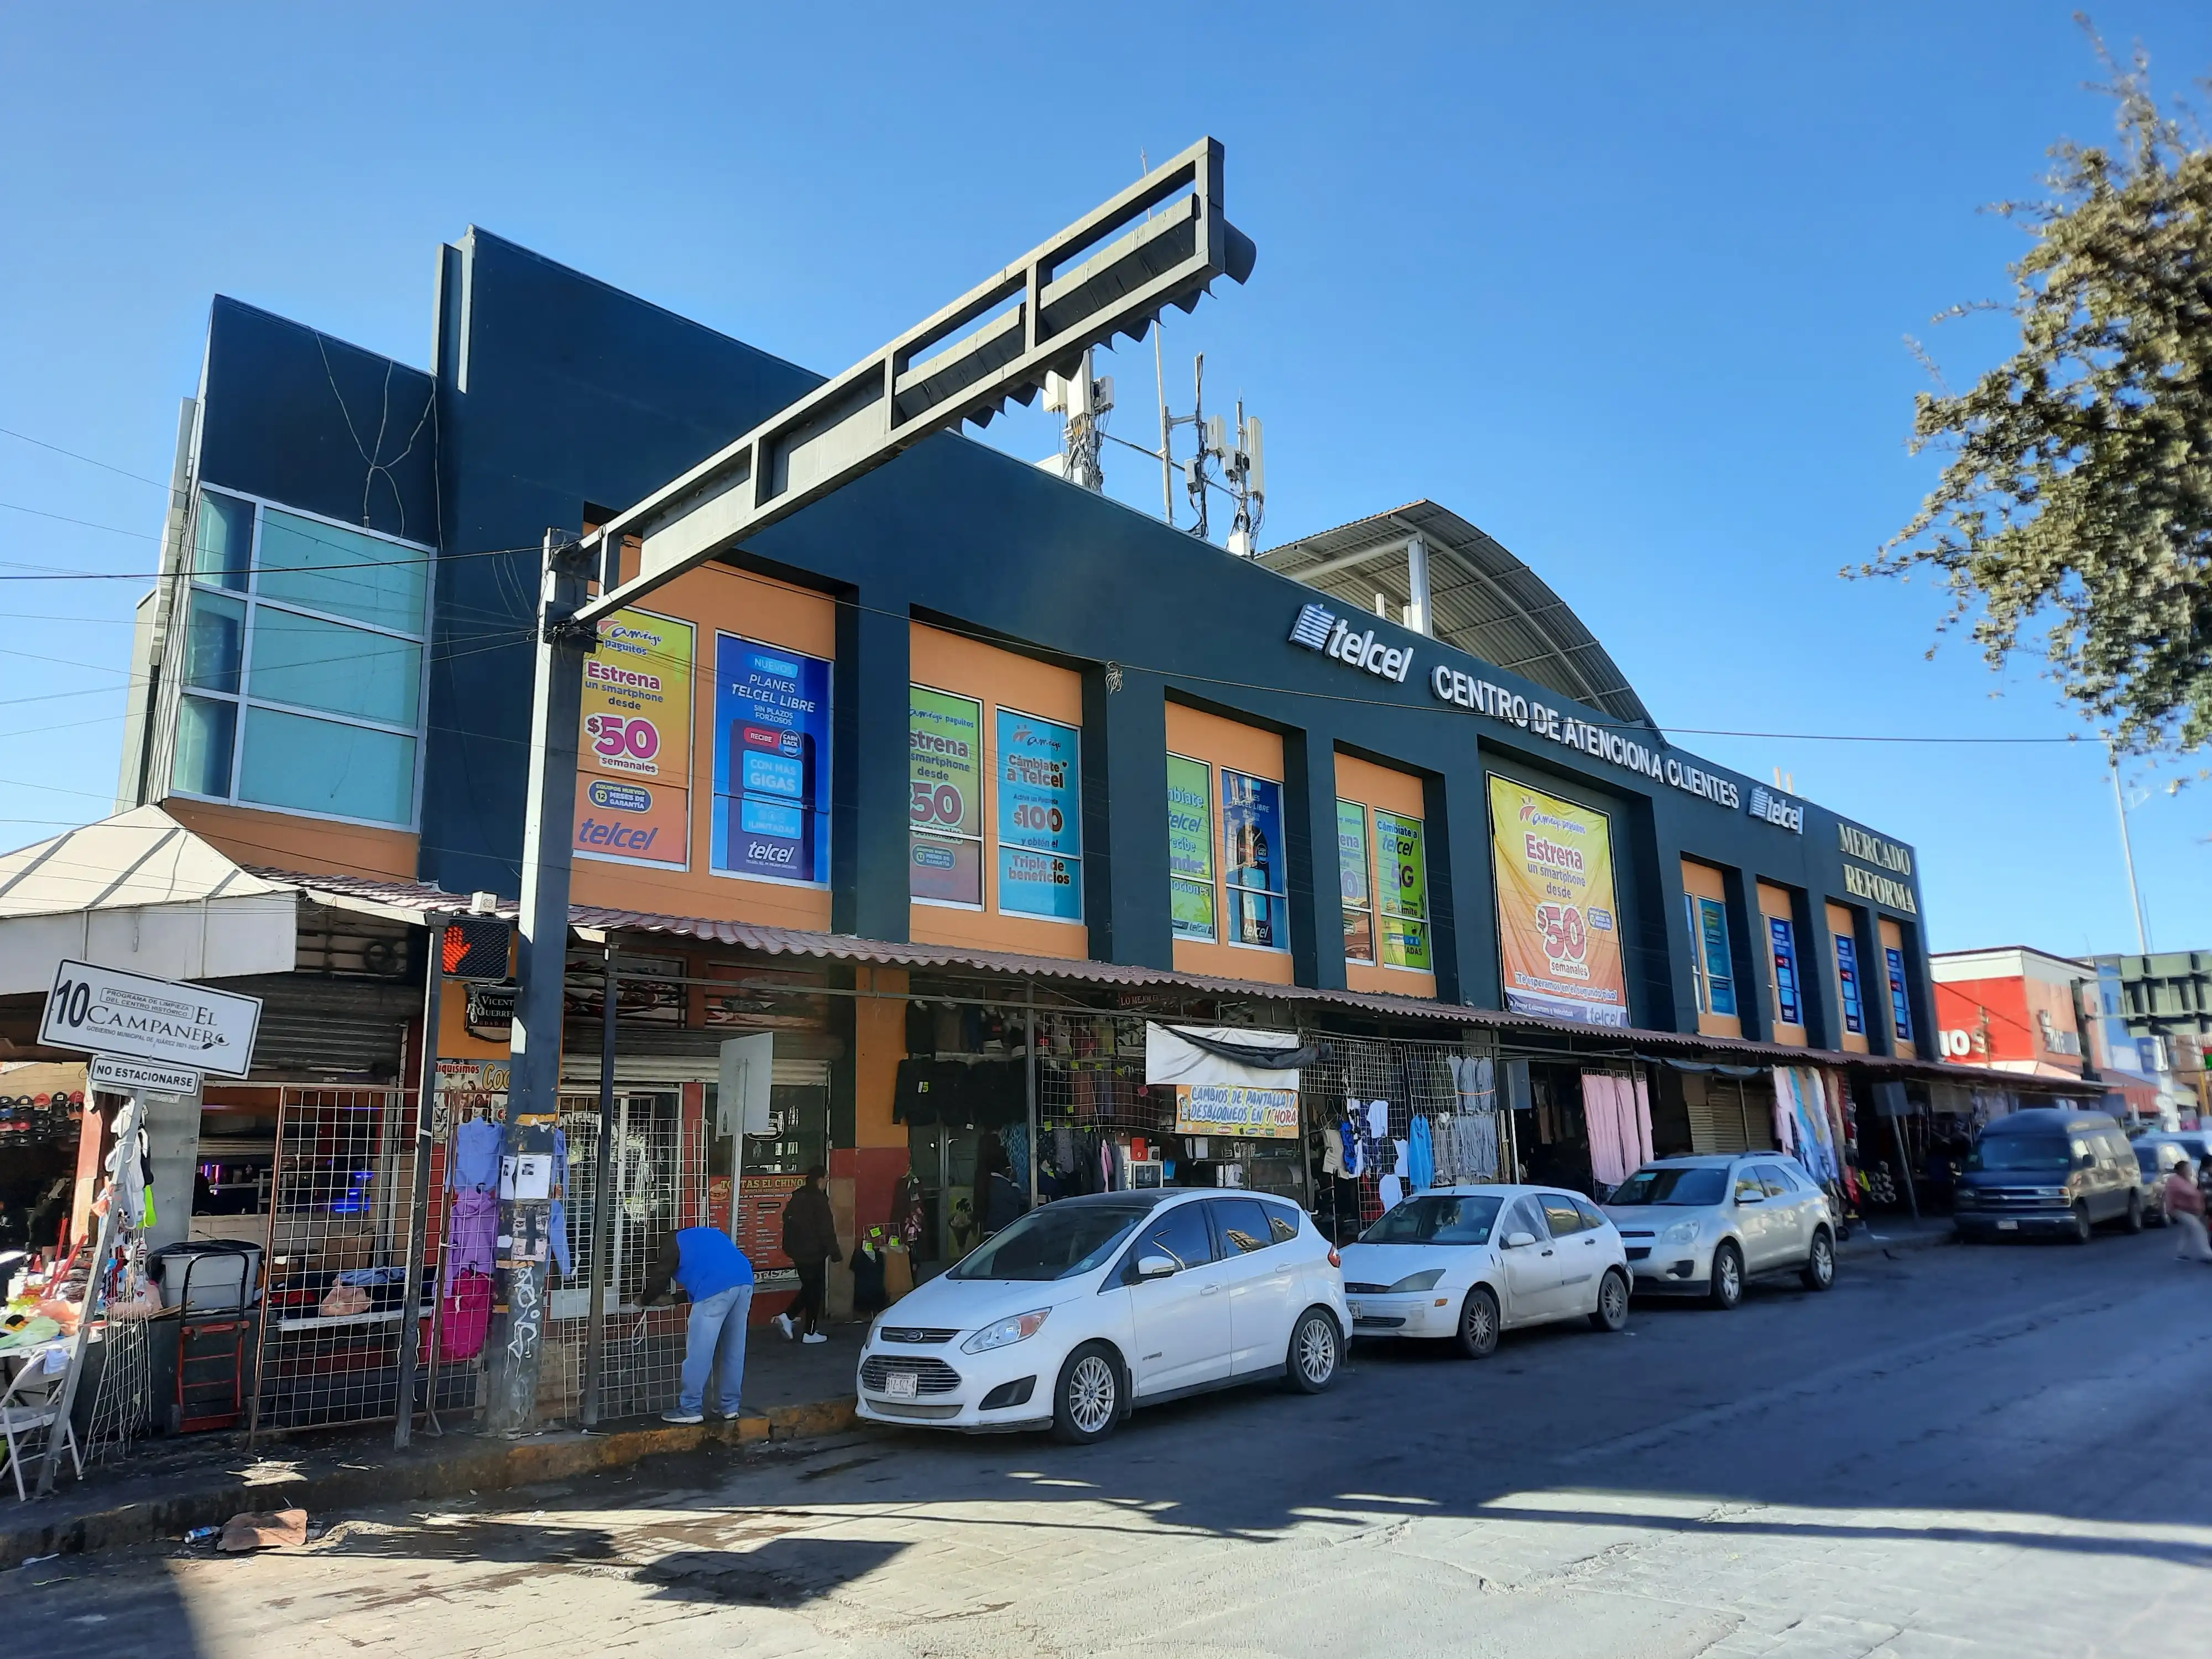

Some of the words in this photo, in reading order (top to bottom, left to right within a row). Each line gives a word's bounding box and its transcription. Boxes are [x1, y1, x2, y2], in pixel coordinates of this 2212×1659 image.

[605, 639, 647, 655] paguitos
[611, 627, 662, 646] amigo
[1326, 618, 1414, 683] telcel
[588, 661, 660, 690] Estrena
[754, 658, 792, 675] NUEVOS
[585, 681, 598, 690] un
[602, 684, 664, 703] smartphone
[749, 674, 796, 693] PLANES
[608, 696, 641, 710] desde
[732, 683, 776, 704] TELCEL
[779, 695, 816, 713] LIBRE
[754, 704, 765, 713] SIN
[766, 707, 794, 719] PLAZOS
[755, 712, 792, 726] FORZOSOS
[945, 716, 974, 728] paguitos
[587, 715, 658, 759] $50
[910, 730, 968, 758] strena
[1431, 665, 1529, 728] CENTRO
[1530, 701, 1561, 742] DE
[1561, 717, 1652, 777] ATENCION
[1665, 758, 1739, 809] CLIENTES
[602, 757, 656, 774] semanales
[910, 753, 971, 771] smartphone
[750, 772, 796, 792] GIGAS
[917, 766, 950, 780] desde
[1007, 768, 1016, 781] a
[1019, 767, 1064, 789] Telcel
[597, 792, 606, 800] 12
[911, 782, 962, 825] 50
[1014, 805, 1063, 832] $100
[1767, 794, 1804, 835] telcel
[578, 818, 659, 851] telcel
[1383, 834, 1414, 856] telcel
[748, 840, 795, 863] telcel
[1525, 833, 1583, 870] Estrena
[1837, 823, 1911, 876] MERCADO
[1012, 855, 1047, 871] Triple
[1050, 859, 1064, 872] de
[1009, 867, 1070, 885] beneficios
[1527, 863, 1538, 874] un
[1540, 867, 1585, 887] smartphone
[1546, 882, 1572, 899] desde
[1843, 863, 1917, 915] REFORMA
[1538, 906, 1585, 959] $50
[1551, 961, 1588, 977] semanales
[56, 979, 91, 1028] 10
[106, 990, 147, 1003] PROGRAMA
[159, 1000, 189, 1011] LIMPIEZA
[121, 999, 150, 1009] CENTRO
[481, 996, 514, 1006] VICENT
[194, 1006, 218, 1026] EL
[476, 1007, 514, 1017] GUERRE
[86, 1025, 116, 1035] GOBIERNO
[97, 1065, 112, 1076] NO
[115, 1067, 194, 1087] ESTACIONARSE
[1191, 1087, 1228, 1104] CAMBIOS
[1232, 1089, 1243, 1104] DE
[1245, 1091, 1287, 1107] PANTALLA
[1288, 1094, 1296, 1108] Y
[1191, 1104, 1248, 1124] DESBLOQUEOS
[1250, 1109, 1263, 1123] EN
[1274, 1109, 1297, 1125] HORA
[721, 1178, 762, 1190] TOTAS
[762, 1180, 773, 1188] EL
[775, 1178, 804, 1188] CHINO
